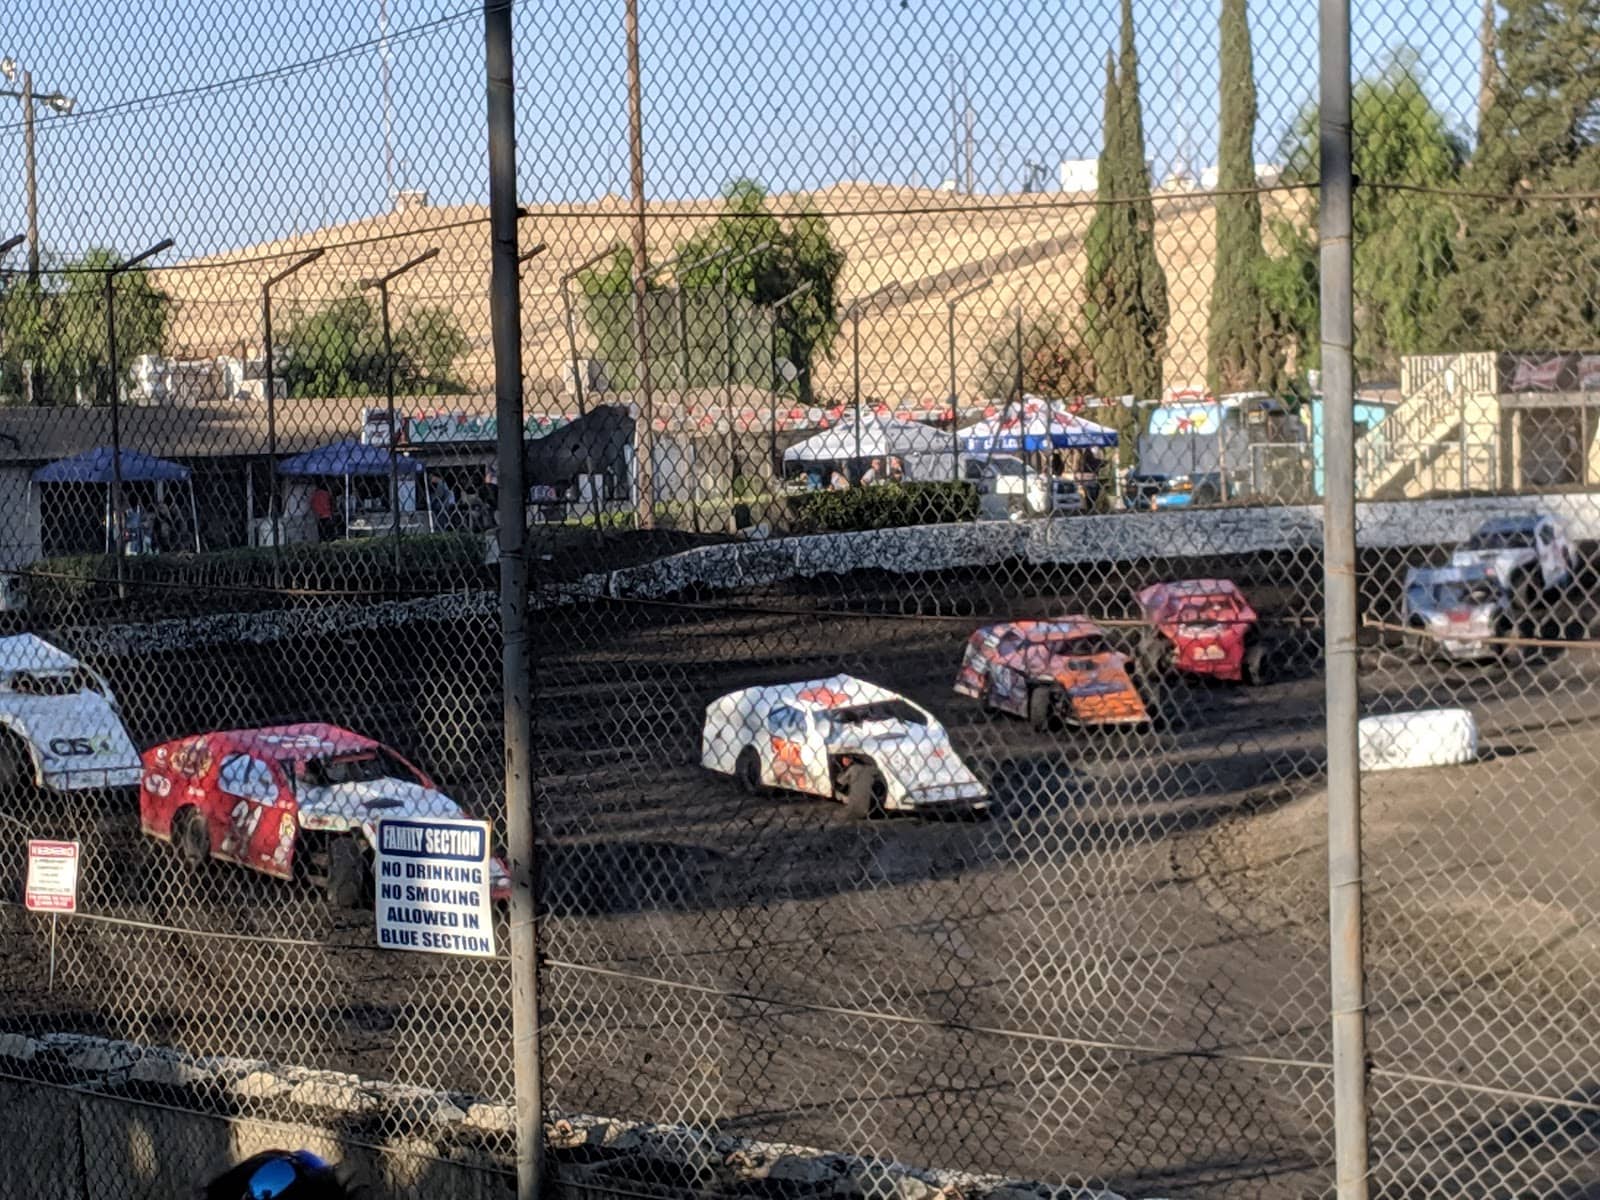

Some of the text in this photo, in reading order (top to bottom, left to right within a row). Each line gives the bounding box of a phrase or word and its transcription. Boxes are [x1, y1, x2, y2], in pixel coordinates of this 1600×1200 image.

[383, 825, 480, 856] FAMILY SECTION
[381, 861, 482, 884] NO DRINKING
[381, 884, 480, 906] NO SMOKING
[387, 907, 479, 929] ALLOWED IN
[381, 928, 490, 952] BLUE SECTION
